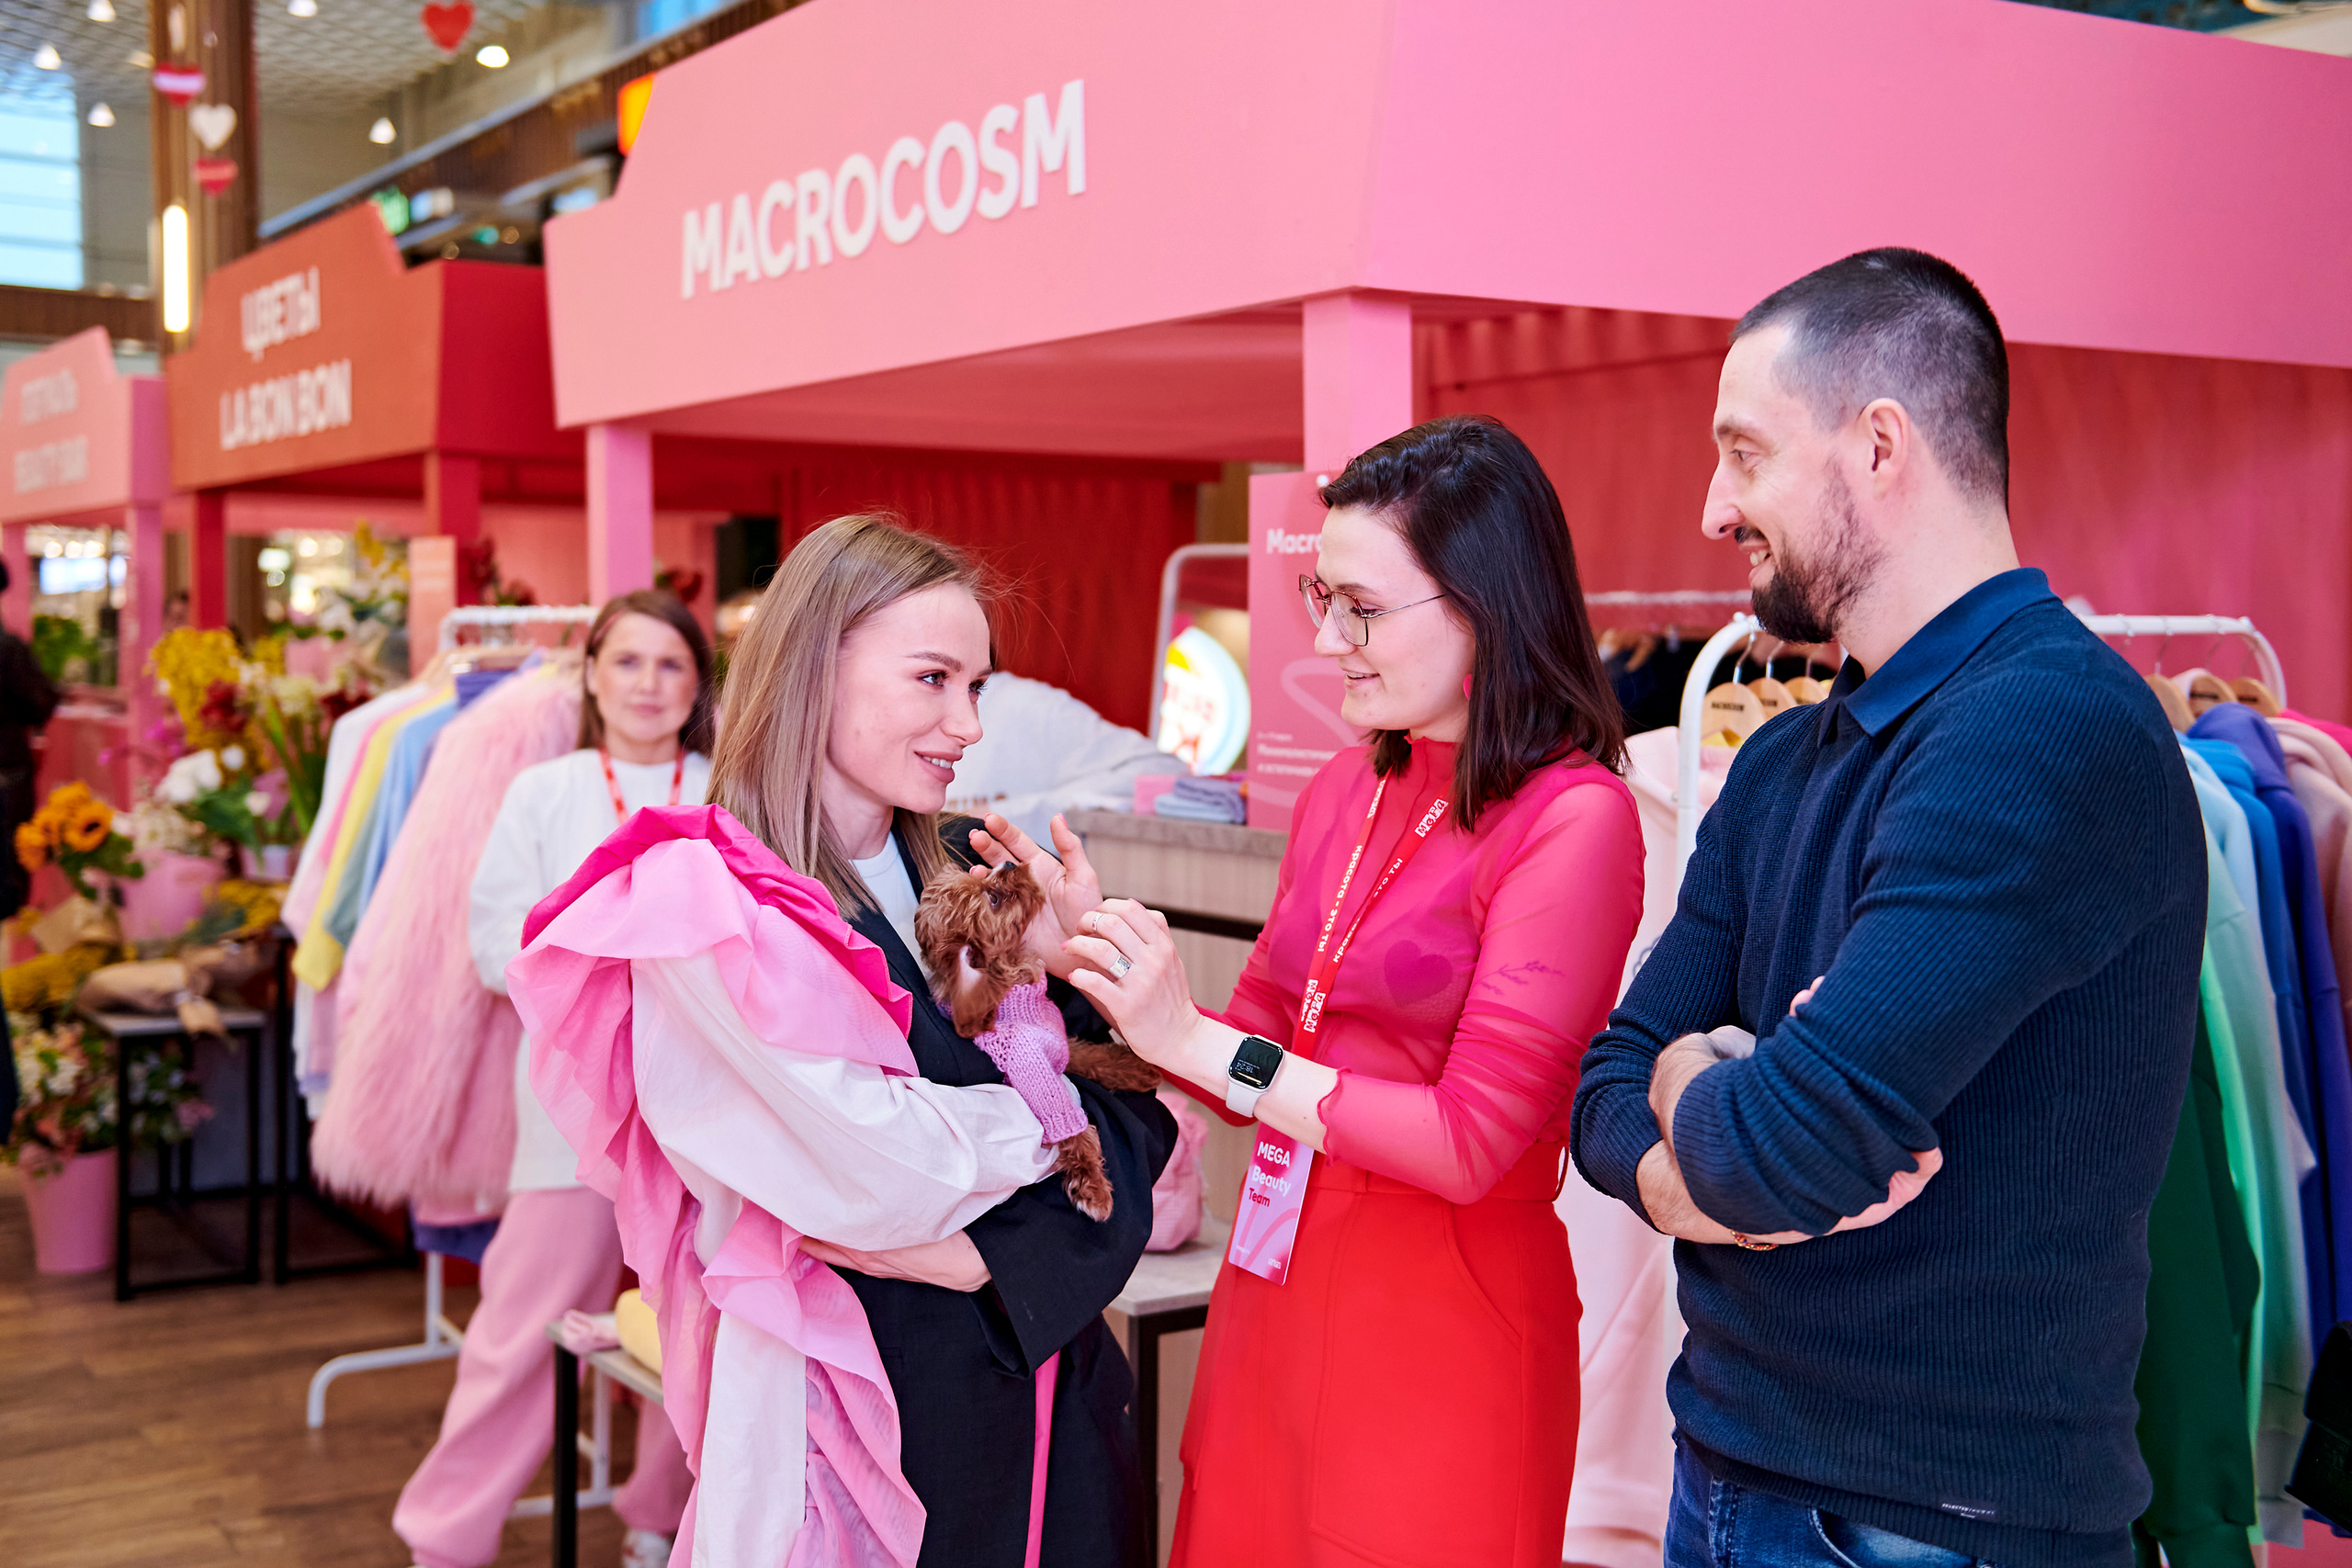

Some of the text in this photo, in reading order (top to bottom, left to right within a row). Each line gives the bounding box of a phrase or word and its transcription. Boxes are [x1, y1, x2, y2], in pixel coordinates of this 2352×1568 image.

[681, 79, 1086, 299] MACROCOSM
[241, 265, 321, 362] ЦВЕТЫ
[1337, 845, 1363, 898] красота
[1388, 857, 1404, 874] ты
[1324, 908, 1338, 931] это
[1317, 933, 1329, 953] ты
[1257, 1141, 1291, 1168] MEGA
[1250, 1165, 1292, 1198] Beauty
[1249, 1187, 1271, 1208] Team
